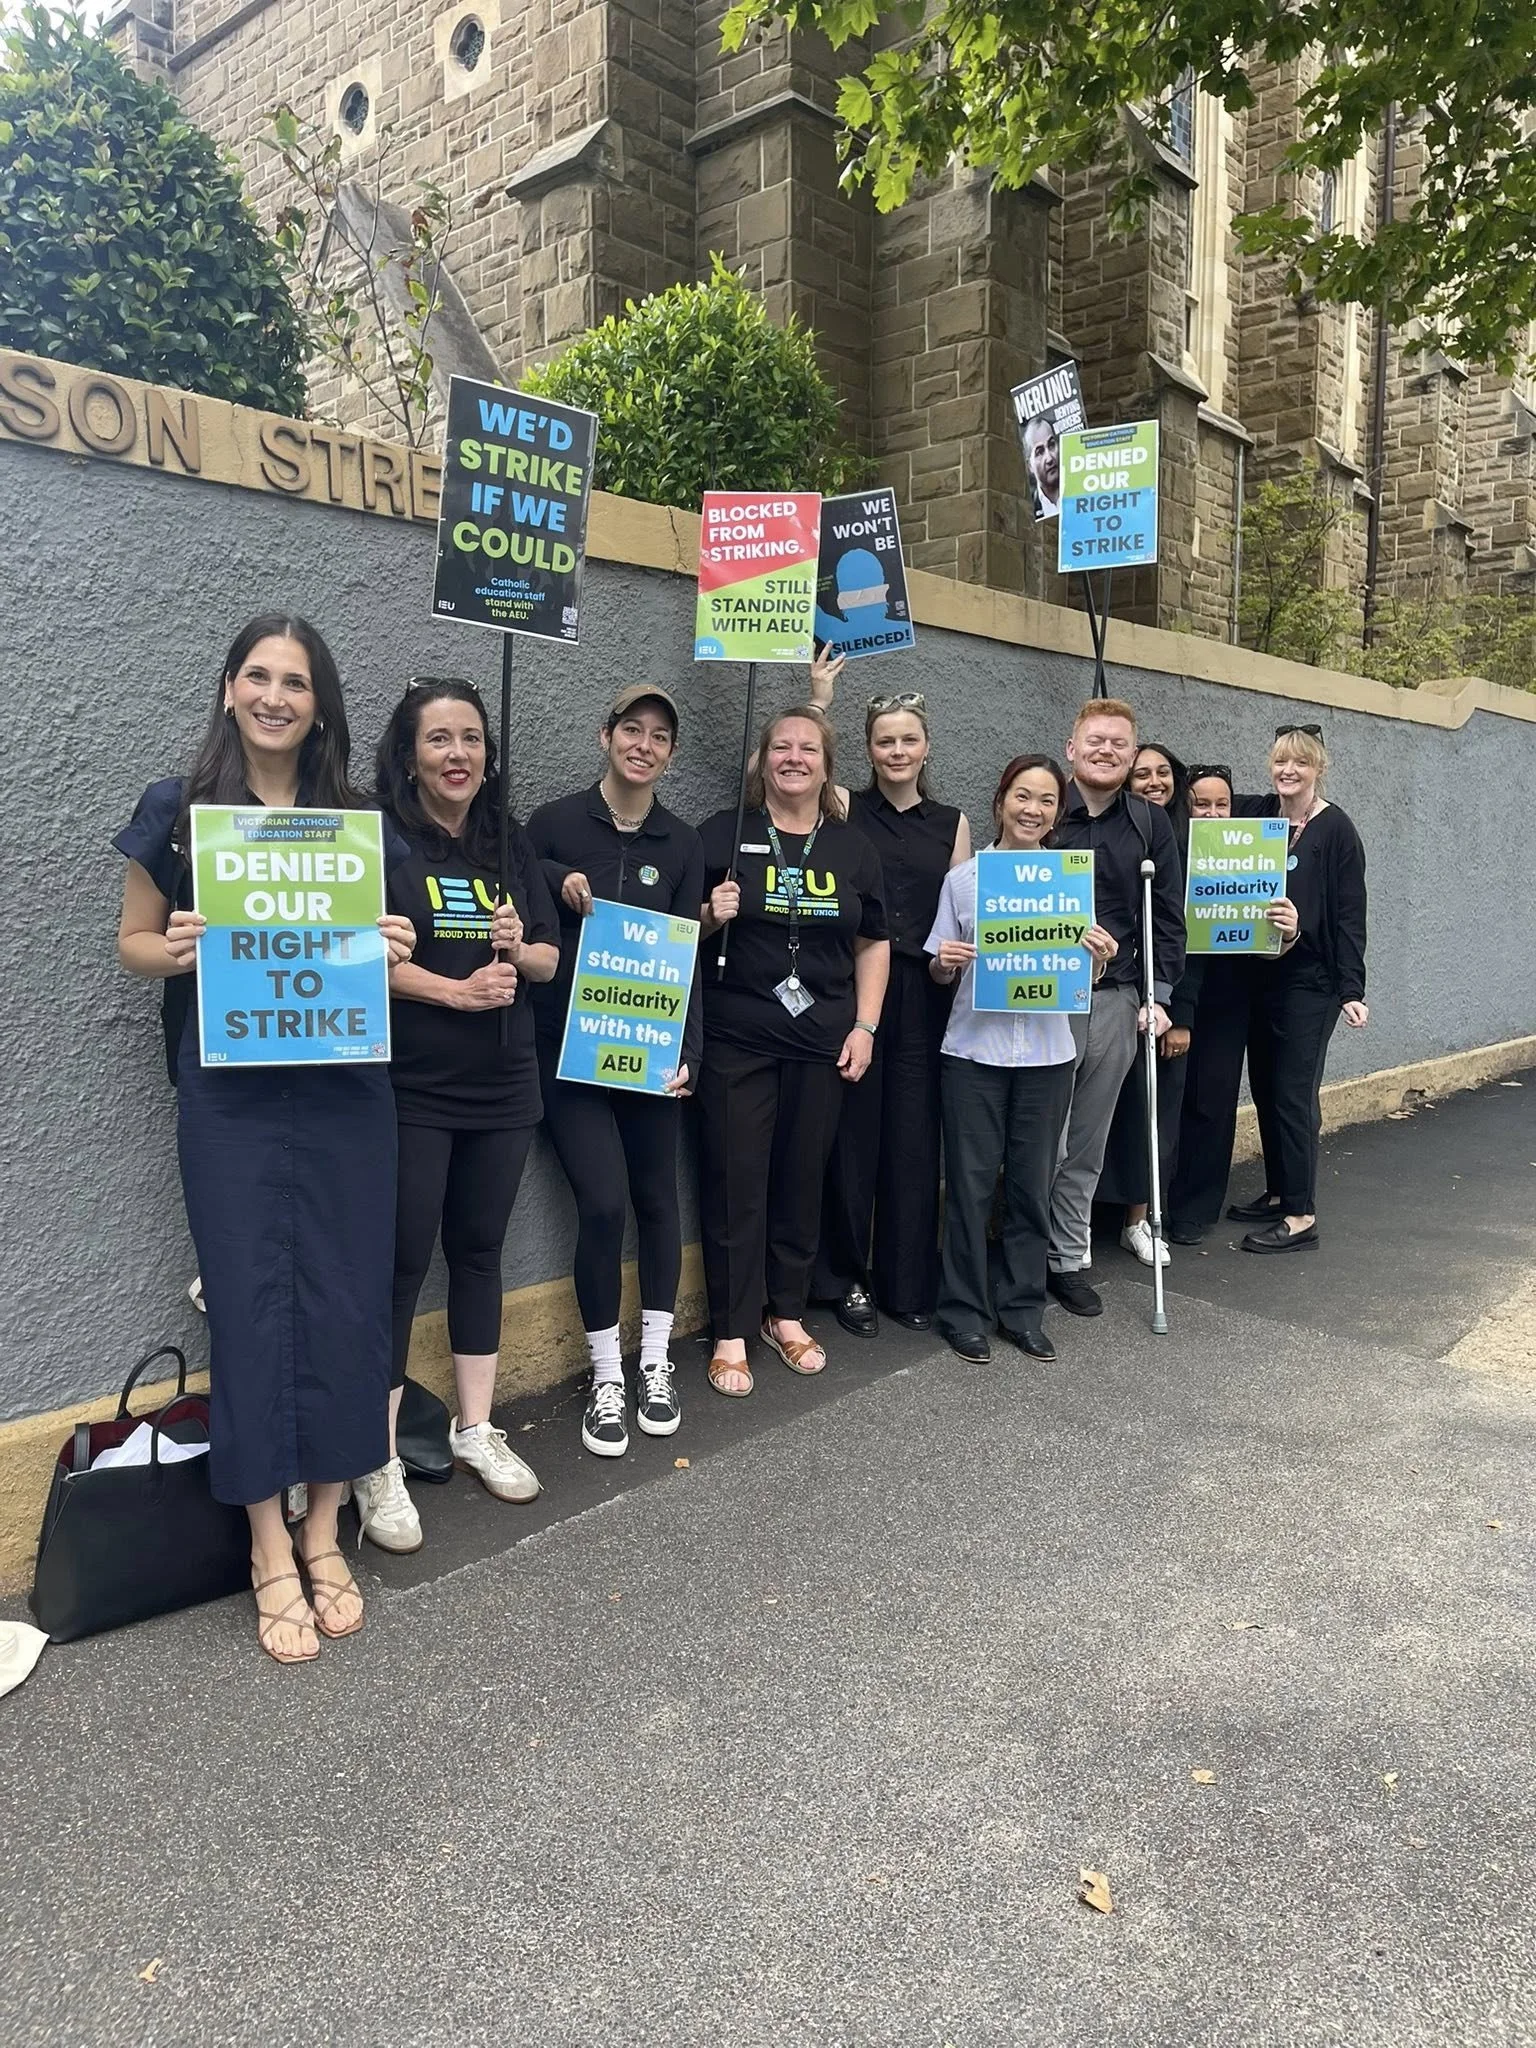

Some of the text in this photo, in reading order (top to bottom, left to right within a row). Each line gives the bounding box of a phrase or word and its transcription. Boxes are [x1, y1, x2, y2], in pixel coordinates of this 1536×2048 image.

[1014, 369, 1077, 424] MERLINO:
[478, 399, 573, 451] WE'D
[459, 438, 583, 497] STRIKE
[1070, 447, 1148, 473] DENIED
[1083, 471, 1129, 492] OUR
[471, 482, 567, 533] IF WE
[708, 501, 797, 523] BLOCKED
[861, 498, 890, 515] WE
[1076, 491, 1141, 514] RIGHT
[709, 523, 765, 543] FROM
[832, 517, 892, 540] WON'T
[1093, 515, 1122, 533] TO
[452, 521, 576, 574] COULD
[710, 539, 805, 562] STRIKING.
[874, 535, 896, 551] BE
[1071, 534, 1144, 557] STRIKE
[490, 577, 530, 589] Catholic
[765, 580, 811, 594] STILL
[475, 587, 546, 601] education staff
[438, 600, 455, 610] IEU
[485, 598, 534, 610] stand with
[711, 598, 810, 613] STANDING
[491, 608, 529, 620] the AEU.
[712, 618, 809, 634] WITH AEU.
[699, 646, 717, 654] IEU
[832, 629, 910, 655] SILENCED!
[237, 817, 339, 827] VICTORIAN CATHOLIC
[247, 830, 333, 839] EDUCATION STAFF
[1222, 830, 1254, 845] We
[215, 851, 366, 882] DENIED
[1070, 855, 1088, 864] IEU
[1196, 854, 1275, 871] stand in
[1014, 864, 1053, 882] We
[1195, 879, 1278, 897] solidarity
[243, 891, 333, 921] OUR
[764, 905, 790, 914] PROUD
[813, 908, 840, 917] UNION
[985, 892, 1080, 913] stand in
[1195, 904, 1238, 919] with
[433, 930, 463, 938] PROUD
[464, 931, 476, 939] TO
[477, 931, 488, 939] BE
[623, 920, 659, 946] We
[676, 923, 694, 935] IEU
[984, 923, 1085, 944] solidarity
[1216, 929, 1250, 943] AEU
[231, 930, 356, 960] RIGHT
[588, 950, 680, 983] stand in
[985, 952, 1081, 972] with the
[266, 969, 323, 999] TO
[1013, 983, 1053, 1000] AEU
[582, 986, 680, 1017] solidarity
[225, 1008, 367, 1039] STRIKE
[580, 1014, 672, 1047] with the
[207, 1052, 227, 1062] IEU
[601, 1054, 642, 1073] AEU
